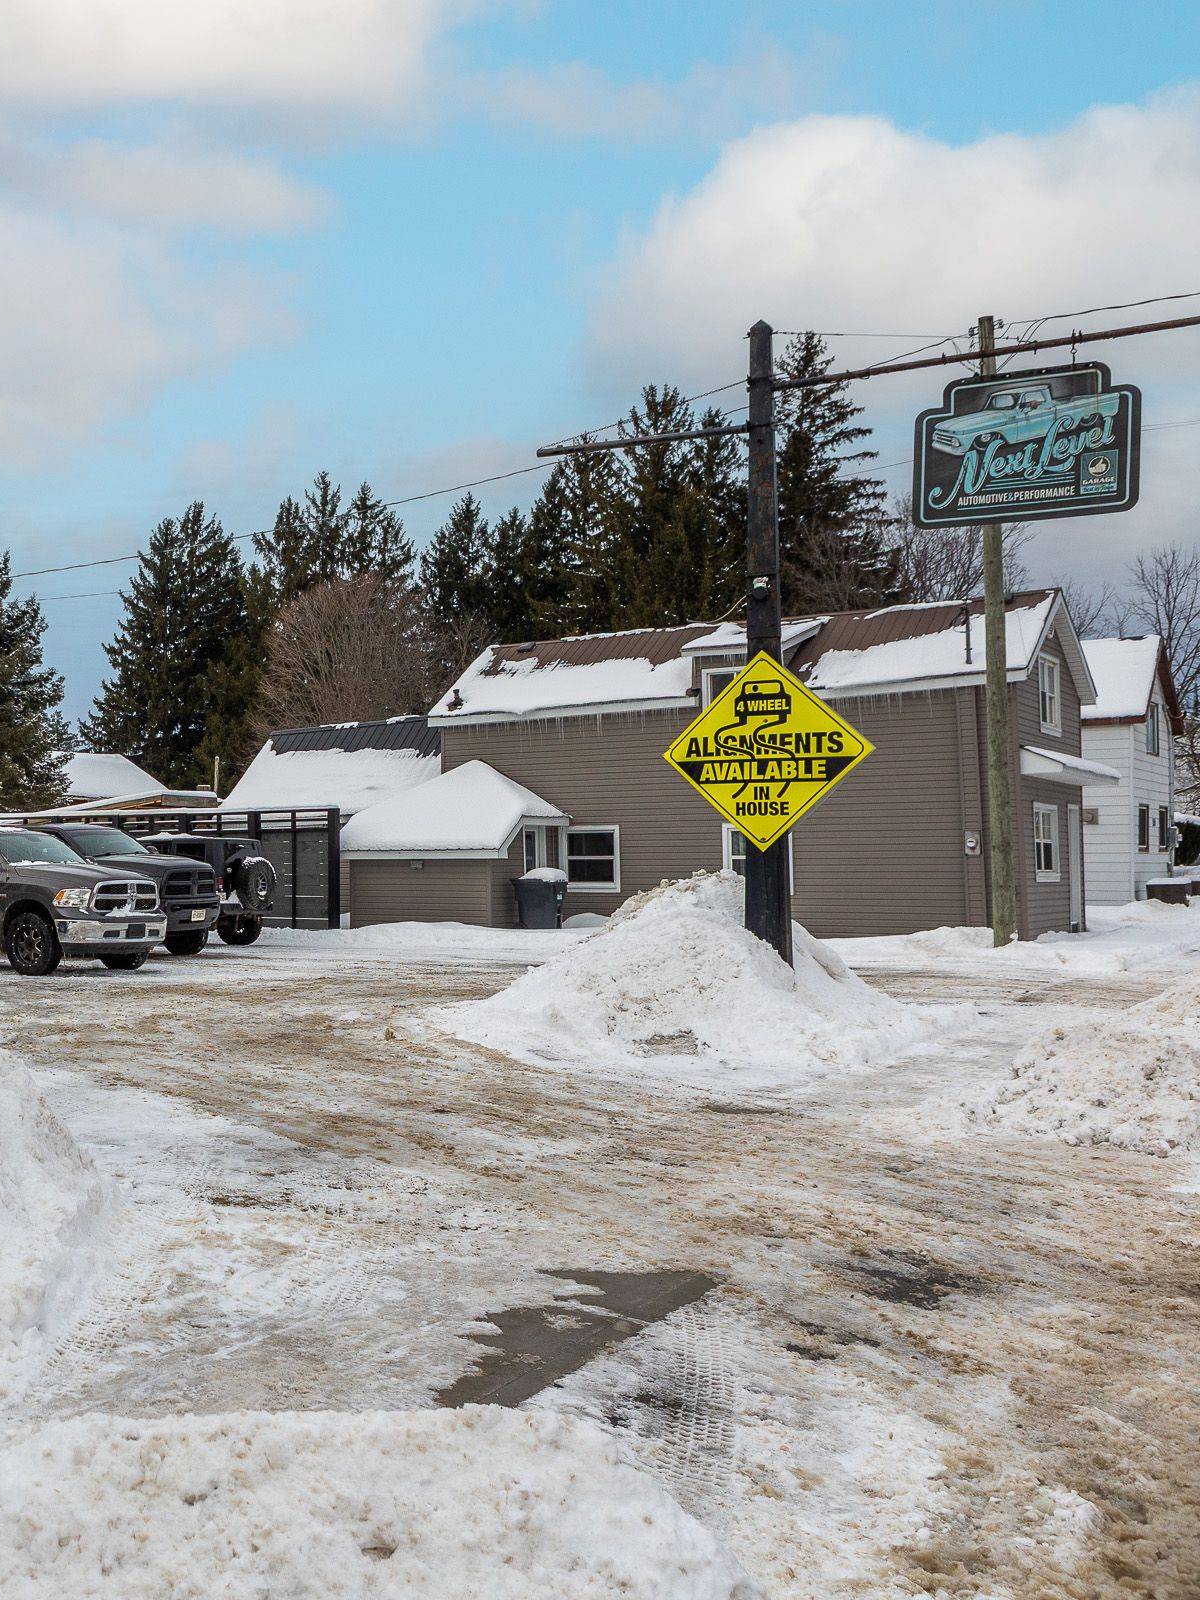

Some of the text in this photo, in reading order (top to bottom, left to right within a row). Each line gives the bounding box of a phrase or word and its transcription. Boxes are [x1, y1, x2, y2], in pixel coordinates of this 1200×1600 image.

[929, 415, 1116, 509] Next Level
[736, 699, 789, 713] 4 WHEEL
[700, 759, 827, 782] AVAILABLE
[753, 786, 770, 801] IN
[735, 801, 790, 816] HOUSE
